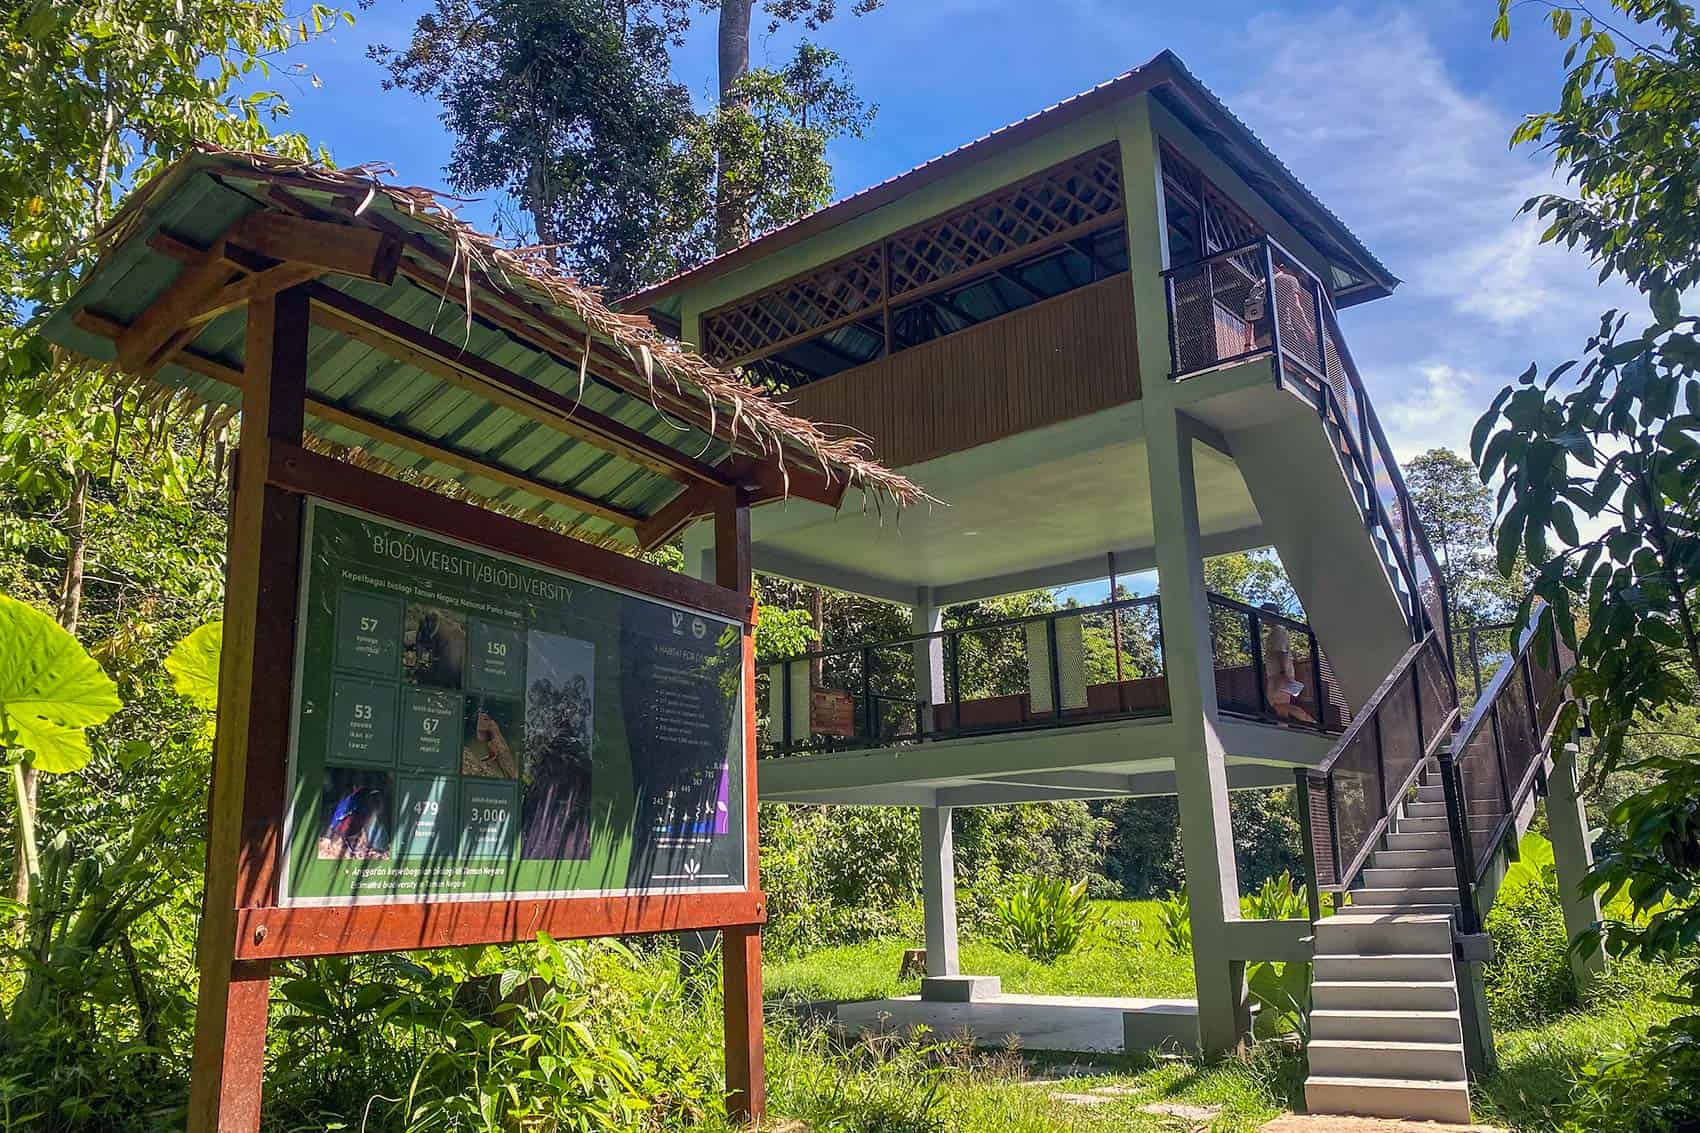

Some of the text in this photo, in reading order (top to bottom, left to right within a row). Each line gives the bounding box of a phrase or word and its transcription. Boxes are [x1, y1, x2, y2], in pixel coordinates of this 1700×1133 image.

[373, 535, 574, 602] BIODIVERSITI/BIODIVERSITY
[360, 617, 378, 632] 57
[487, 641, 506, 657] 150
[354, 704, 372, 719] 53
[423, 718, 439, 732] 67
[414, 801, 439, 816] 479
[471, 808, 506, 824] 3,000
